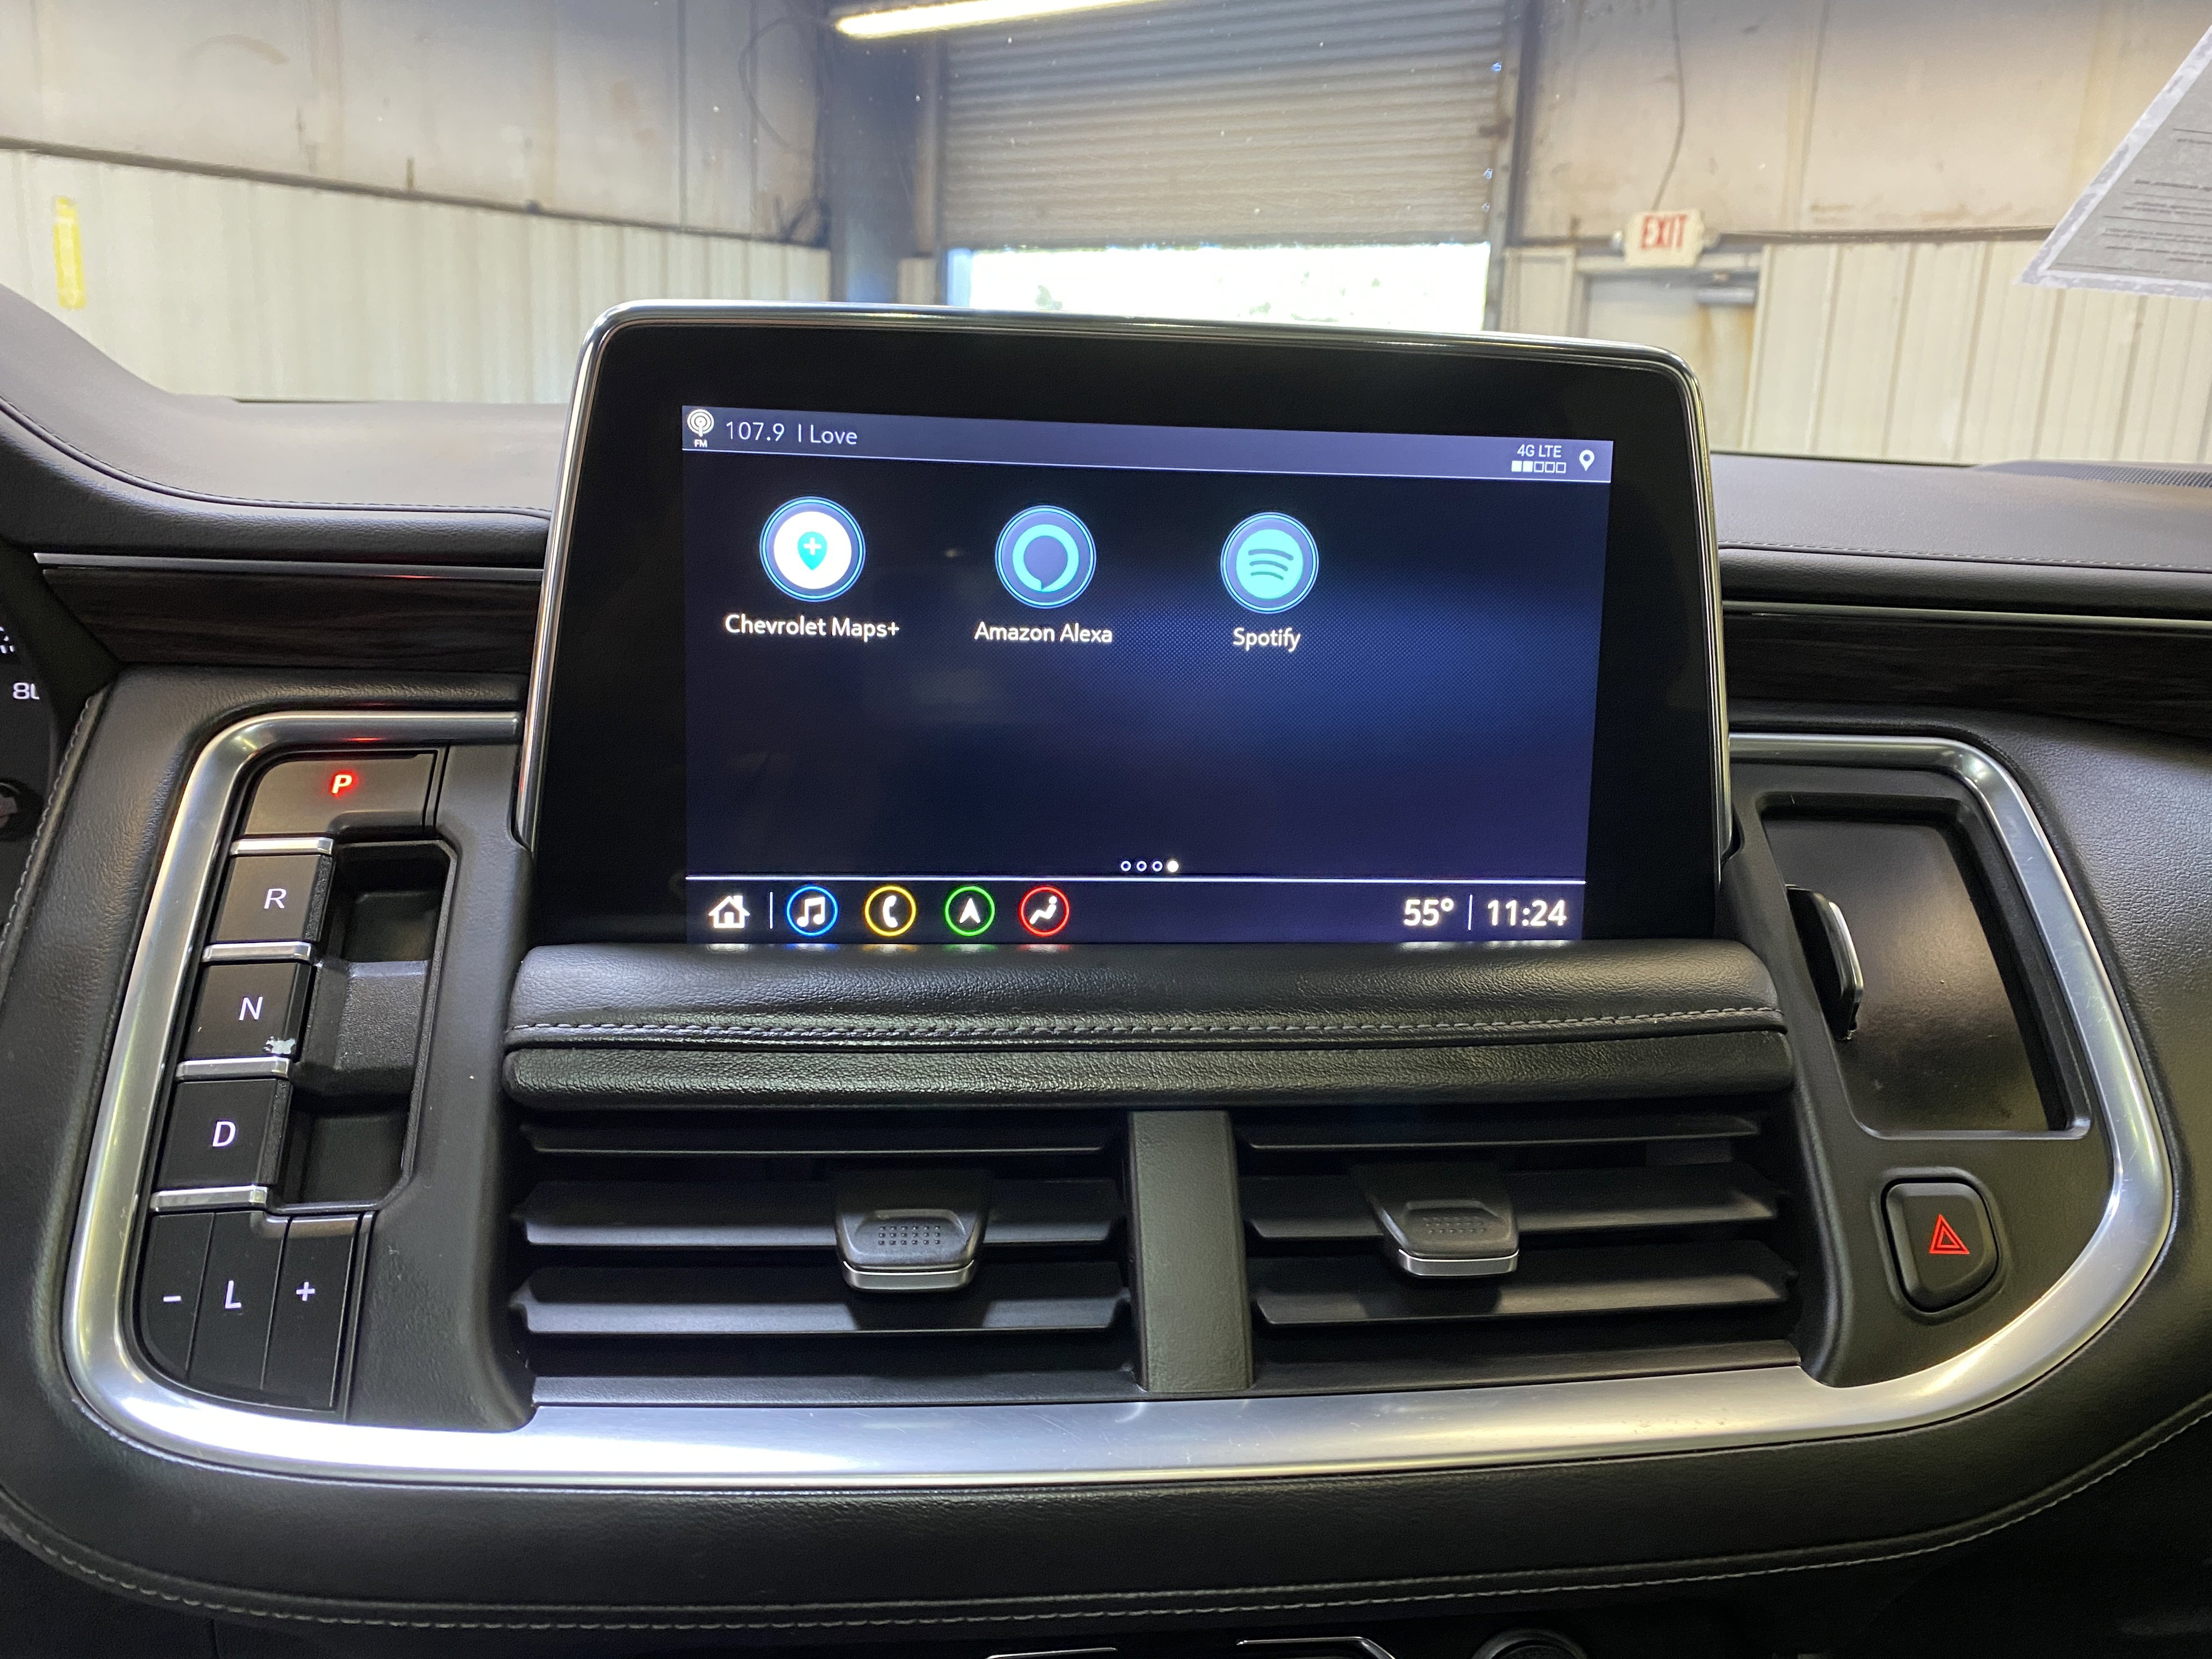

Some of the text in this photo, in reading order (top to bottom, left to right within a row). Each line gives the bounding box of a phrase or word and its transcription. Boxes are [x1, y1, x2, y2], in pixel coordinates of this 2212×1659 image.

[1640, 213, 1687, 251] EXIT
[694, 439, 708, 448] FM
[726, 421, 785, 442] 107.9
[810, 424, 858, 445] Love
[1517, 444, 1562, 458] 4G LTE
[725, 613, 900, 643] Chevrolet Maps+
[974, 621, 1113, 643] Amazon Alexa
[1233, 627, 1301, 652] Spotify
[331, 774, 353, 794] P
[264, 888, 287, 910] R
[1487, 900, 1567, 927] 11:24
[239, 996, 263, 1021] N
[212, 1120, 237, 1148] D
[224, 1280, 242, 1310] L
